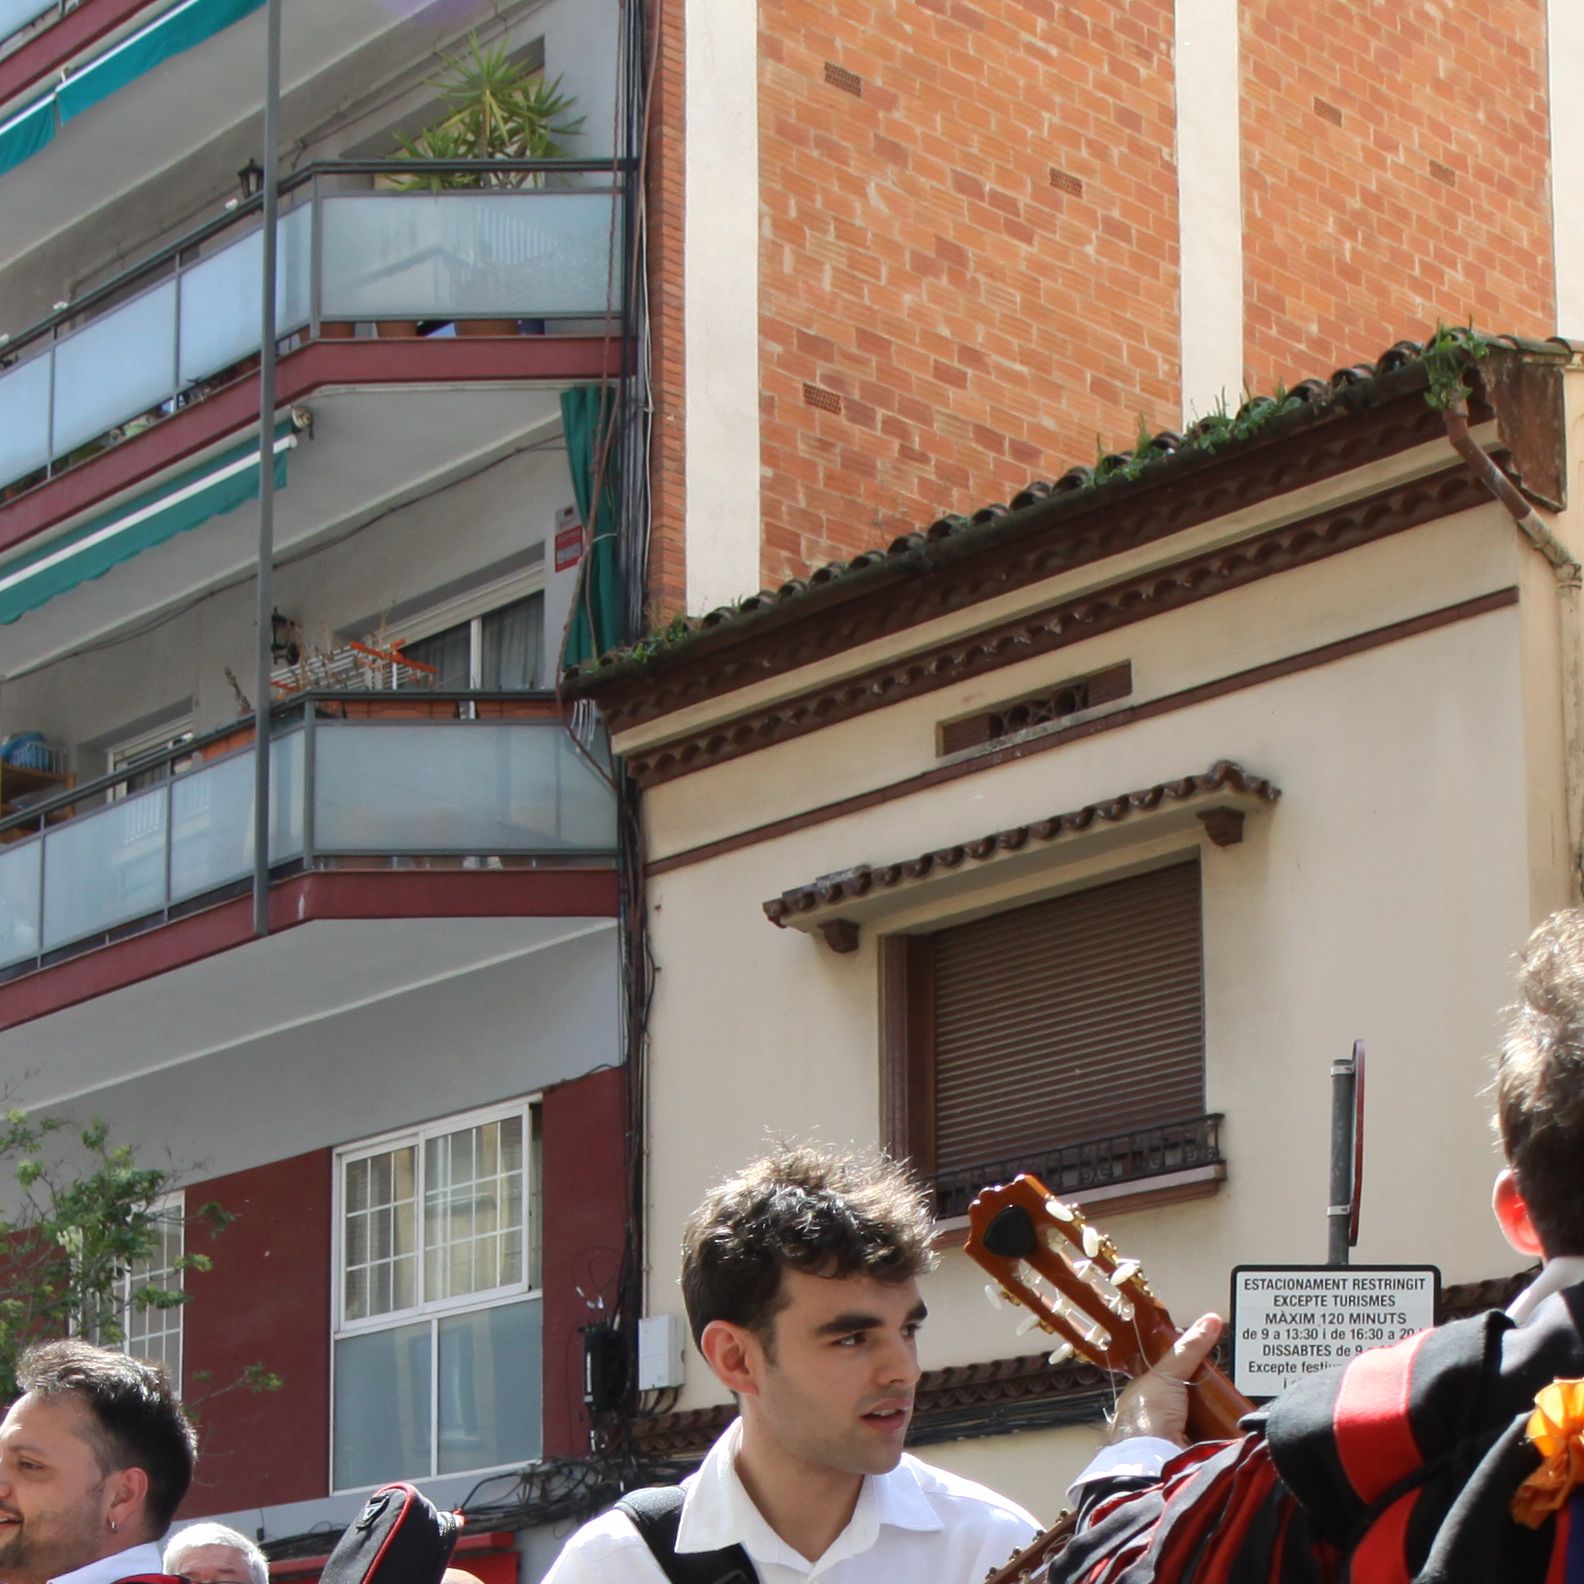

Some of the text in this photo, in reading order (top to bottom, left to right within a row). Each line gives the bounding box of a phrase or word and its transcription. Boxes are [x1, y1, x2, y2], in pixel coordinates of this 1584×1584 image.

[1244, 1278, 1425, 1290] ESTACIONAMENT RESTRINGIT
[1273, 1295, 1396, 1307] EXCEPTE TURISMES
[1265, 1310, 1407, 1325] MÀXIM 120 MINUTS
[1242, 1328, 1257, 1340] de
[1261, 1328, 1269, 1340] 9
[1273, 1331, 1280, 1340] a
[1285, 1328, 1318, 1340] 13:30
[1331, 1328, 1345, 1340] de
[1350, 1328, 1383, 1340] 16:30
[1388, 1331, 1395, 1340] a
[1263, 1344, 1363, 1357] DISSABTES de 9
[1248, 1361, 1297, 1376] Excepte
